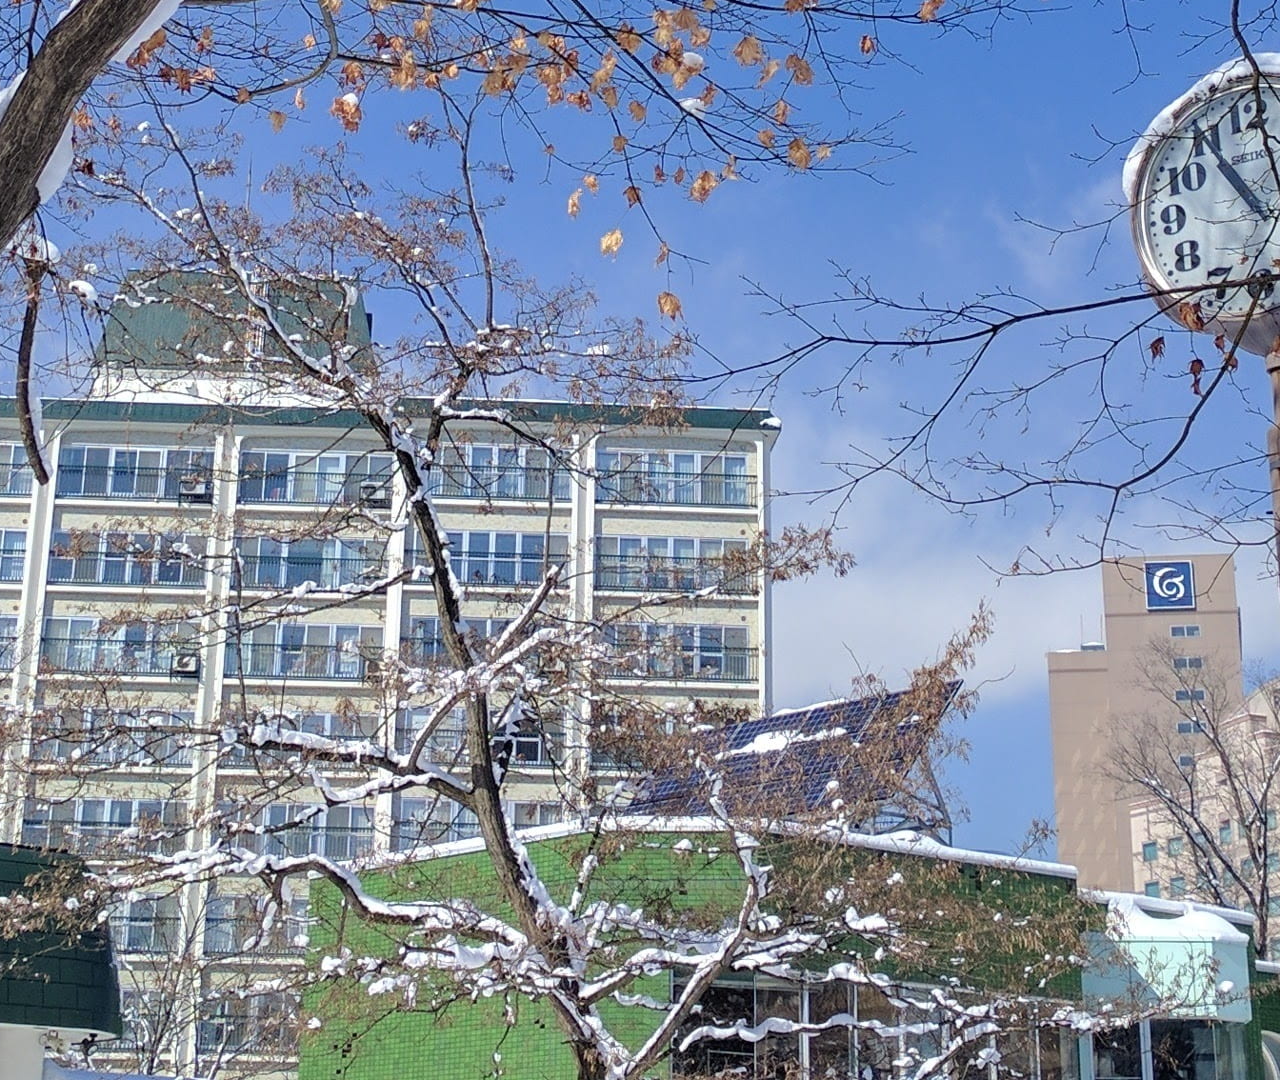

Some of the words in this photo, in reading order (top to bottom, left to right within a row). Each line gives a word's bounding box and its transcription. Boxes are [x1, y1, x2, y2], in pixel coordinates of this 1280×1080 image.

[1229, 100, 1270, 135] 12
[1167, 161, 1207, 197] 10
[1160, 204, 1187, 235] 9
[1174, 240, 1201, 272] 8
[1207, 265, 1234, 300] 7
